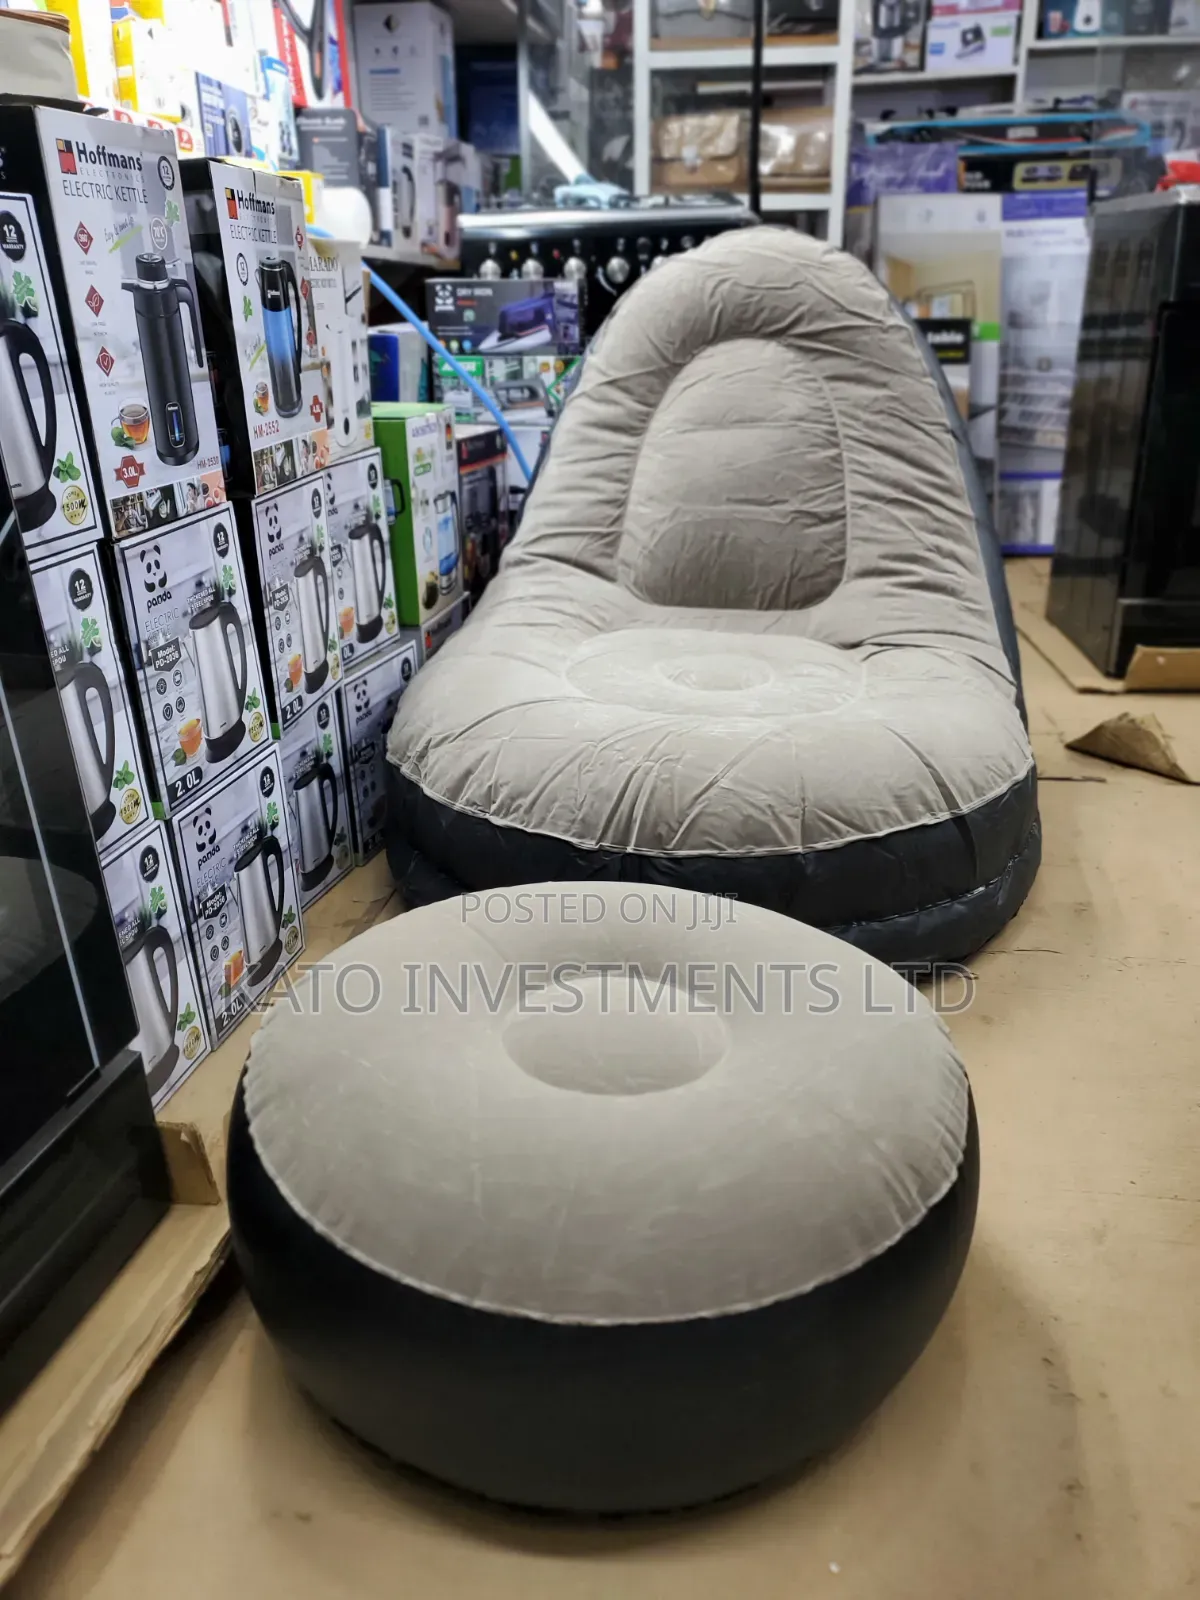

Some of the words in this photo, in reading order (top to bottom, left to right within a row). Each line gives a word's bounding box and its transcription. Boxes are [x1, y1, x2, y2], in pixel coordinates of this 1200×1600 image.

[76, 141, 142, 171] Hoffmans
[162, 165, 169, 175] 12
[63, 180, 113, 200] ELECTRIC
[115, 186, 148, 204] KETTLE
[237, 190, 275, 215] Hoffmans
[3, 224, 17, 237] 12
[230, 224, 258, 243] ELECTRIC
[257, 228, 277, 244] KETTLE
[253, 420, 280, 439] HM-2552
[122, 465, 138, 479] 3.0L
[217, 531, 225, 542] 12
[74, 579, 87, 591] 12
[146, 590, 172, 613] panda
[144, 608, 180, 632] ELECTRIC
[157, 644, 177, 660] Model:
[144, 854, 154, 866] 12
[197, 844, 221, 871] panda
[196, 857, 227, 888] ELECTRIC
